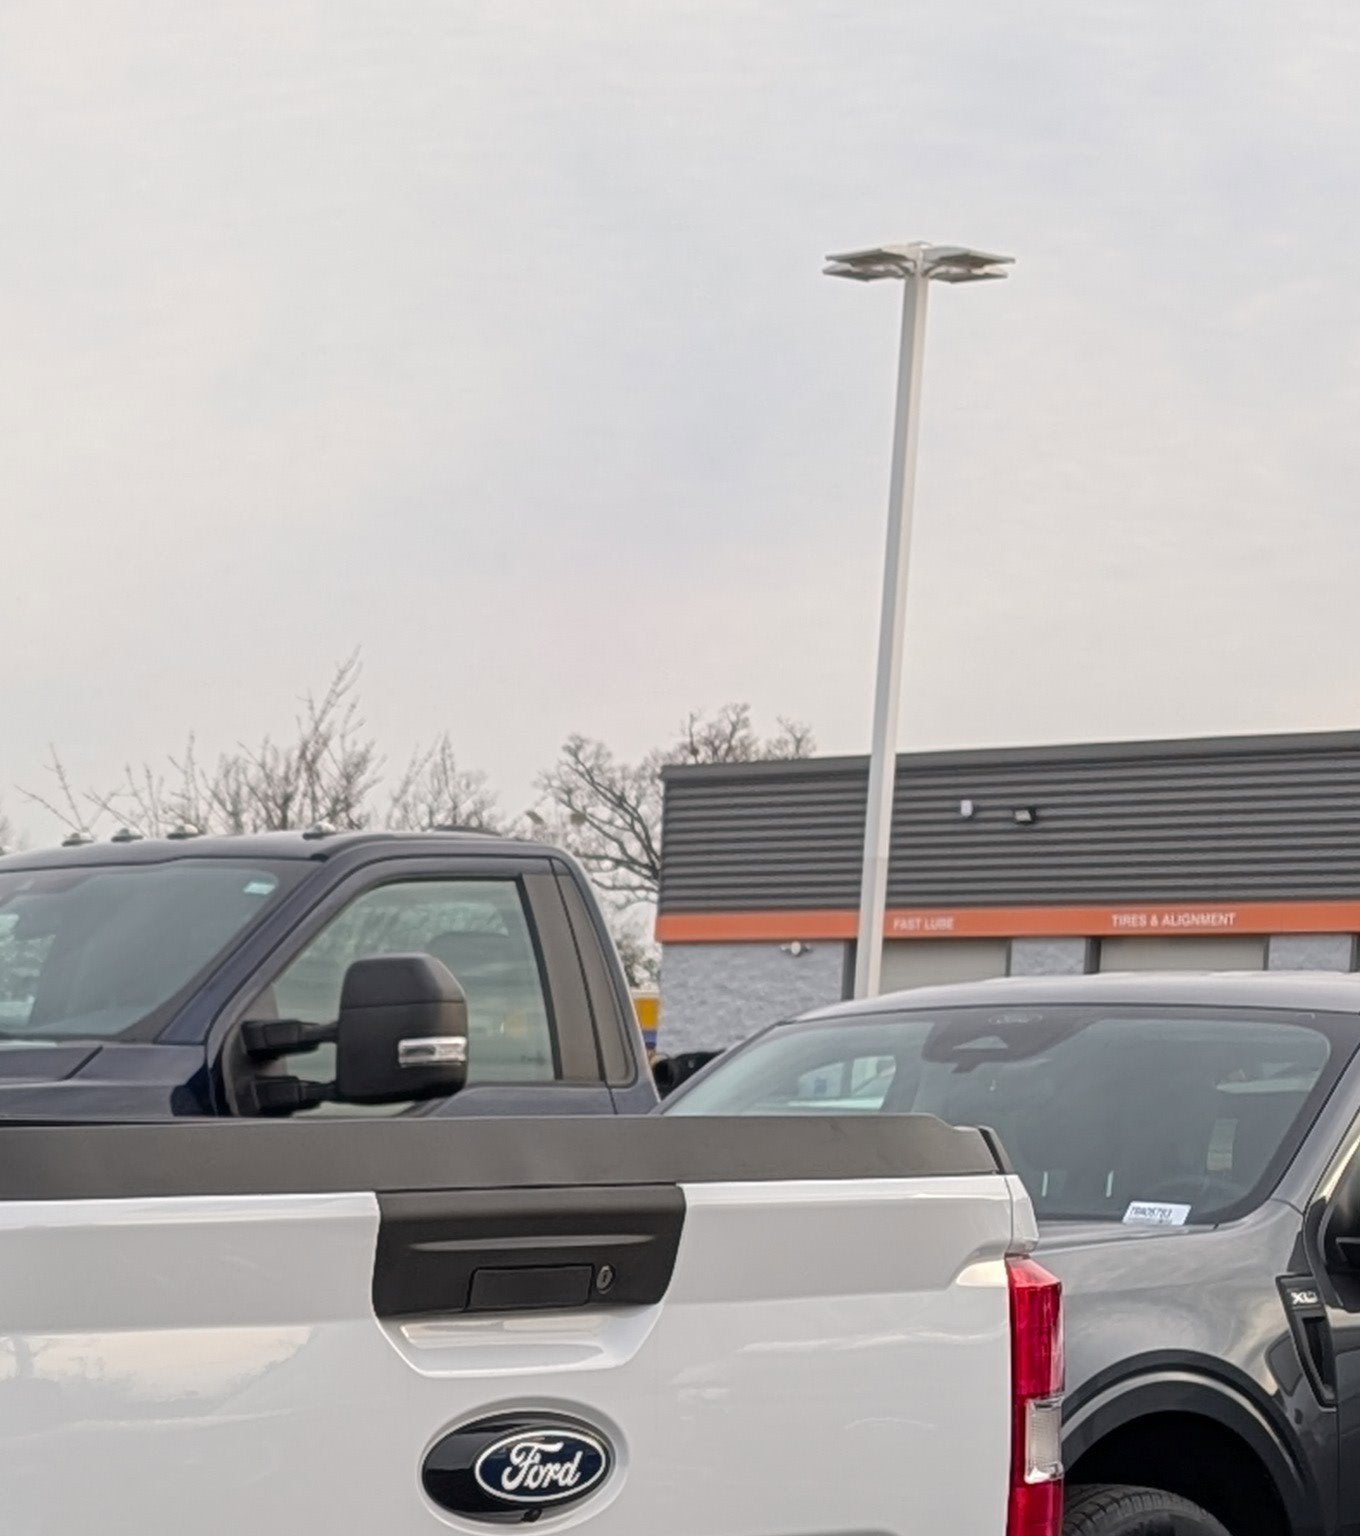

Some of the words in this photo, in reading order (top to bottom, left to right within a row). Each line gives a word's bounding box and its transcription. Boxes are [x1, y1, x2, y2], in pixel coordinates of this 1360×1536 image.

[892, 916, 921, 931] FAST
[923, 916, 954, 931] LUBE
[1111, 913, 1147, 928] TIRES
[1150, 913, 1158, 928] &
[1161, 911, 1236, 927] ALIGNMENT
[501, 1441, 583, 1490] Ford
